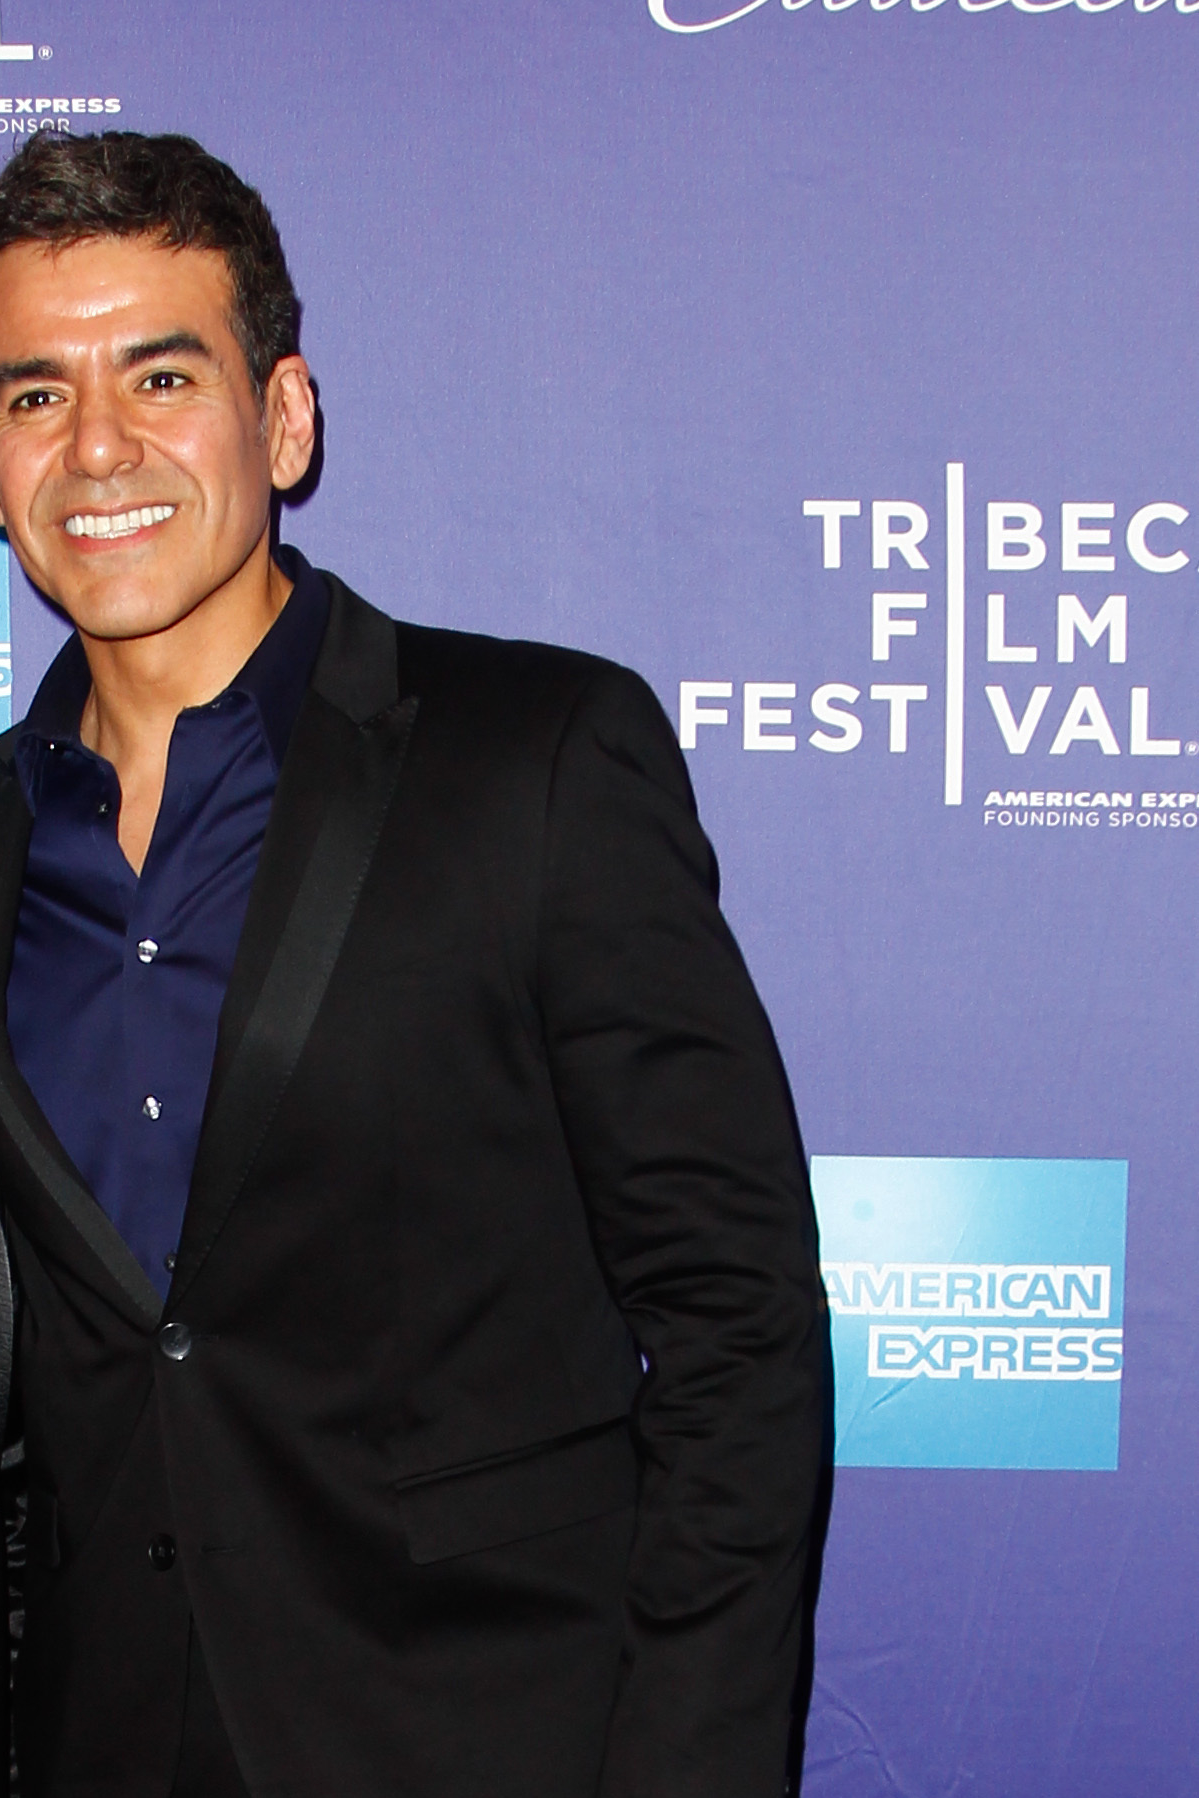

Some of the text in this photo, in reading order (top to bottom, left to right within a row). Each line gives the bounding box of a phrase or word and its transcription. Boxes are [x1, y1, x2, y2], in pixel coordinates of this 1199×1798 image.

[983, 790, 1199, 809] AMERICAN EXP
[983, 809, 1101, 828] FOUNDING
[822, 1266, 1106, 1314] AMERICAN
[874, 1329, 1125, 1376] EXPRESS
